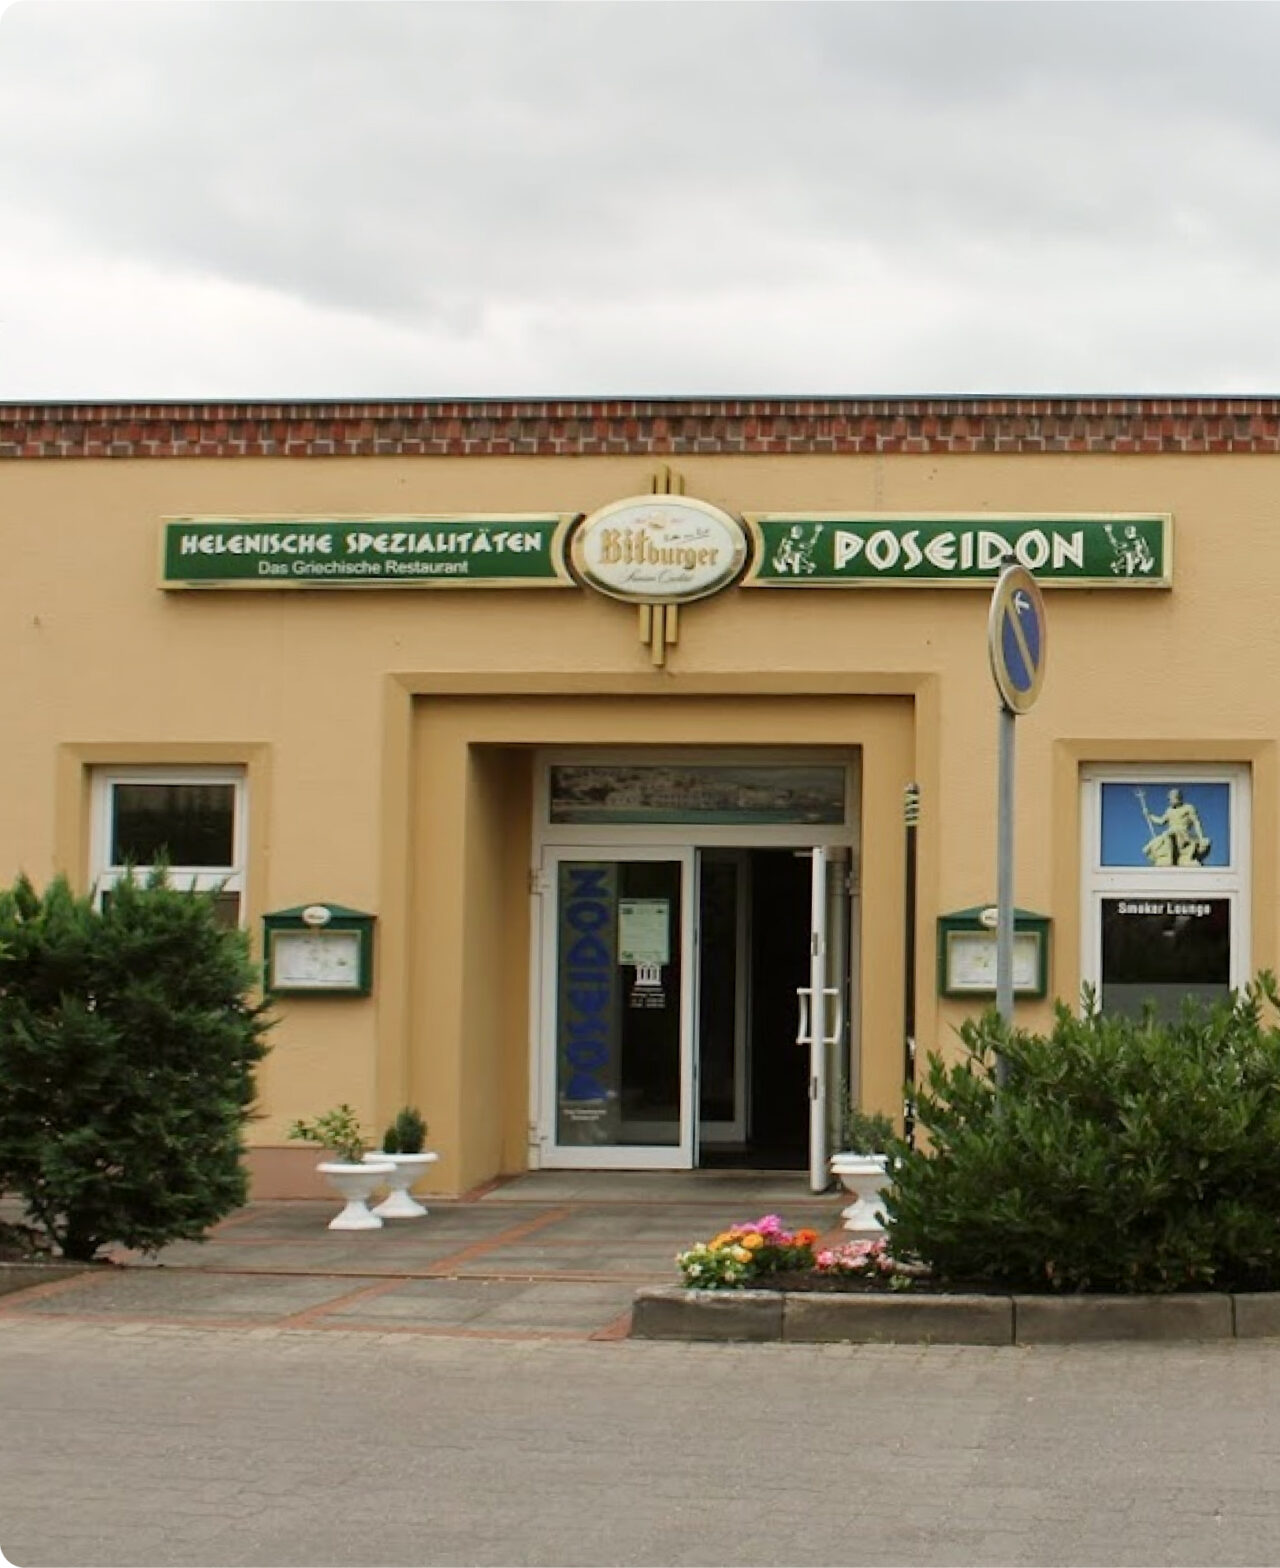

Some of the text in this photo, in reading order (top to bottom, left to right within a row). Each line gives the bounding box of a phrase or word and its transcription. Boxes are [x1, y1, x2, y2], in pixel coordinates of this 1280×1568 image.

[179, 527, 542, 555] HELENISCHE SPEZIALITÄTEN
[599, 528, 719, 570] Bitburger
[833, 529, 1084, 571] POSEIDON
[258, 559, 469, 575] Das Griechische Restaurant
[1118, 901, 1212, 917] Smoker Lounge
[565, 868, 610, 1101] POSEIDON
